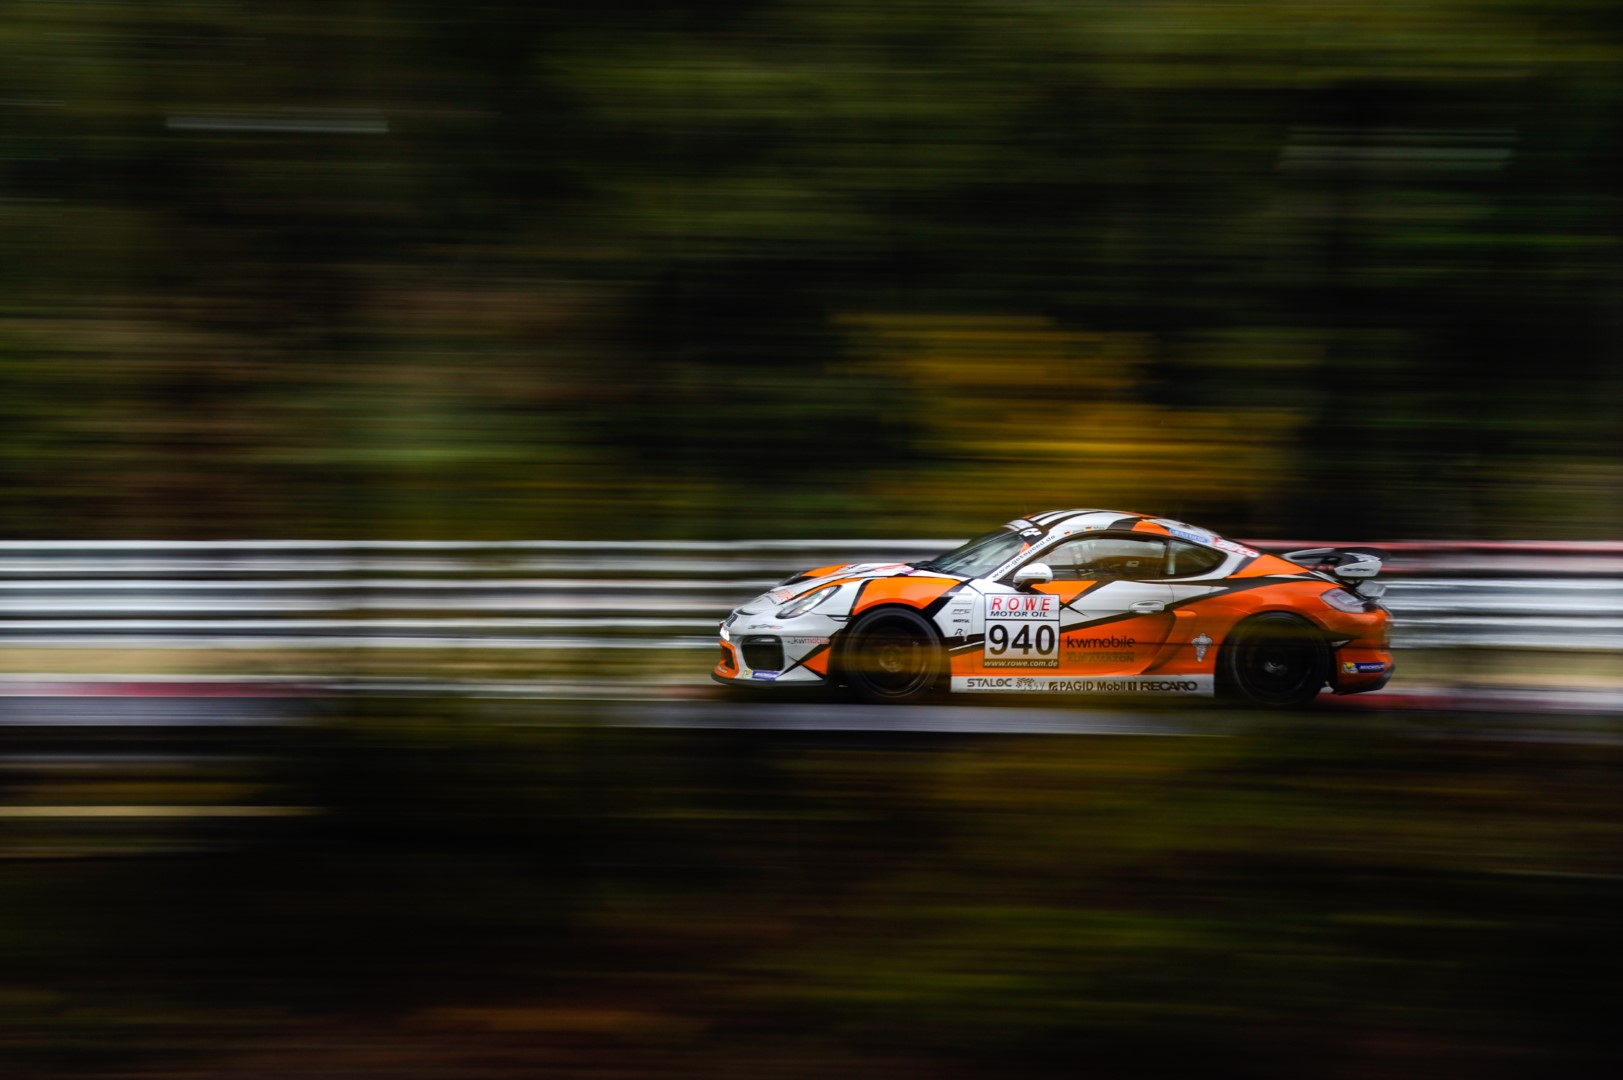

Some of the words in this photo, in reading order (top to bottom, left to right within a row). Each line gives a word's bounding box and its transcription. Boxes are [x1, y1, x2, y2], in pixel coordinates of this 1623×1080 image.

[991, 597, 1051, 611] ROWE
[989, 624, 1055, 656] 940
[1066, 635, 1136, 648] kwmobile
[967, 678, 1012, 688] STALOC
[1060, 681, 1094, 691] PAGID
[1096, 682, 1126, 692] Mobil
[1140, 681, 1198, 691] RECARO
